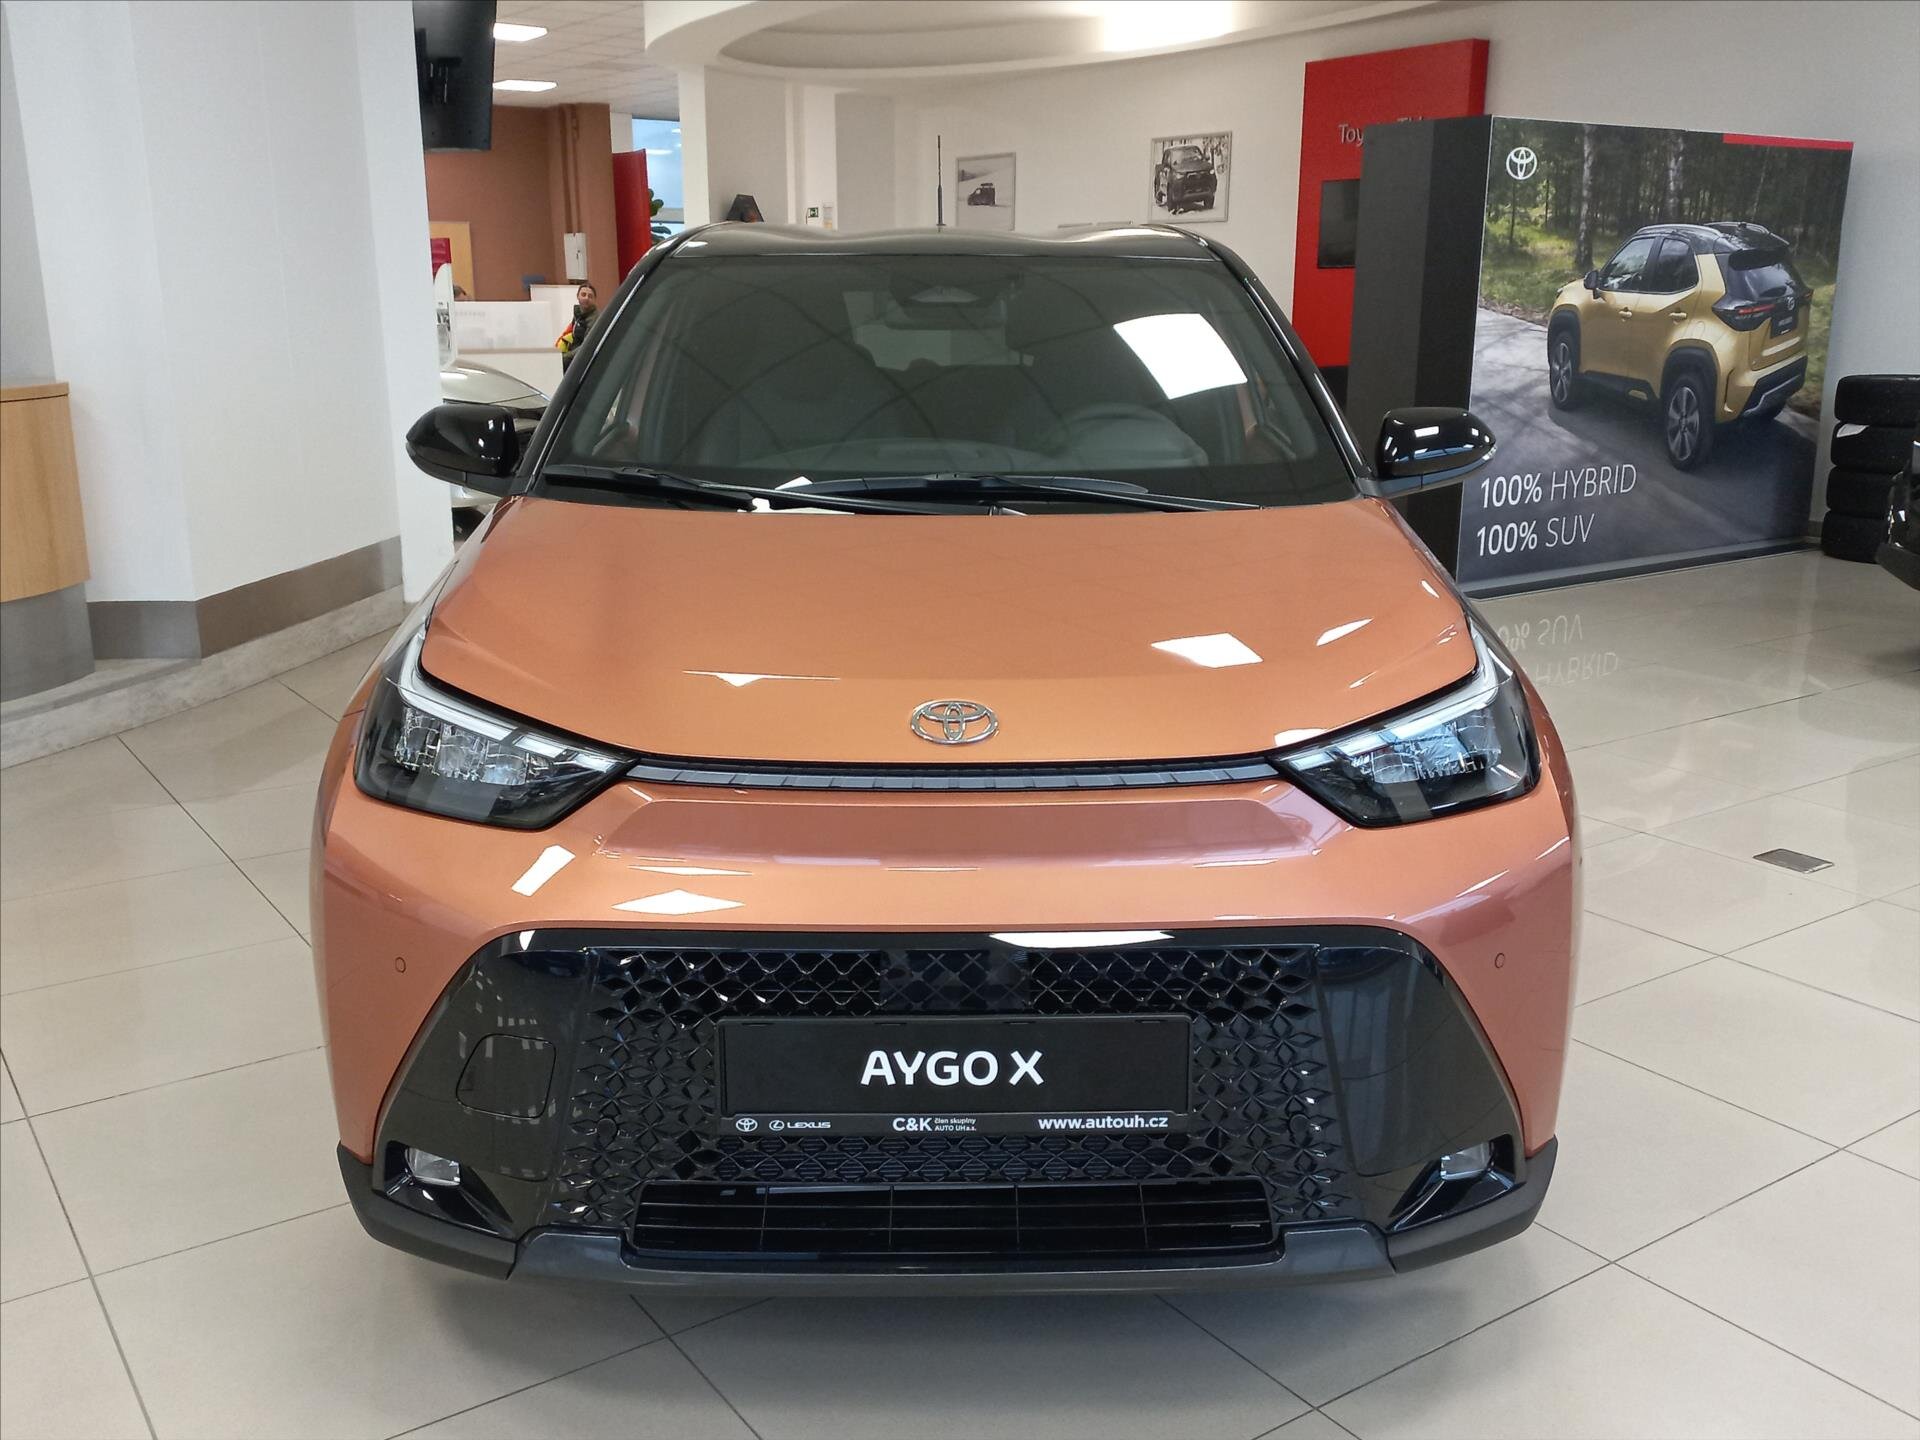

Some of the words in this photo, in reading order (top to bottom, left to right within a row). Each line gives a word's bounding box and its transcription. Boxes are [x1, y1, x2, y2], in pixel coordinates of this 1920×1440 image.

[1338, 123, 1364, 147] Toy
[1480, 472, 1543, 509] 100%
[1550, 463, 1637, 501] HYBRID
[1476, 520, 1538, 557] 100%
[1545, 513, 1595, 548] SUV
[860, 1050, 999, 1086] AYGO
[1008, 1050, 1045, 1086] X
[786, 1121, 832, 1129] LEXUS
[892, 1117, 933, 1132] C&K
[950, 1117, 977, 1125] skupiny
[1038, 1115, 1169, 1130] www.autouh.cz
